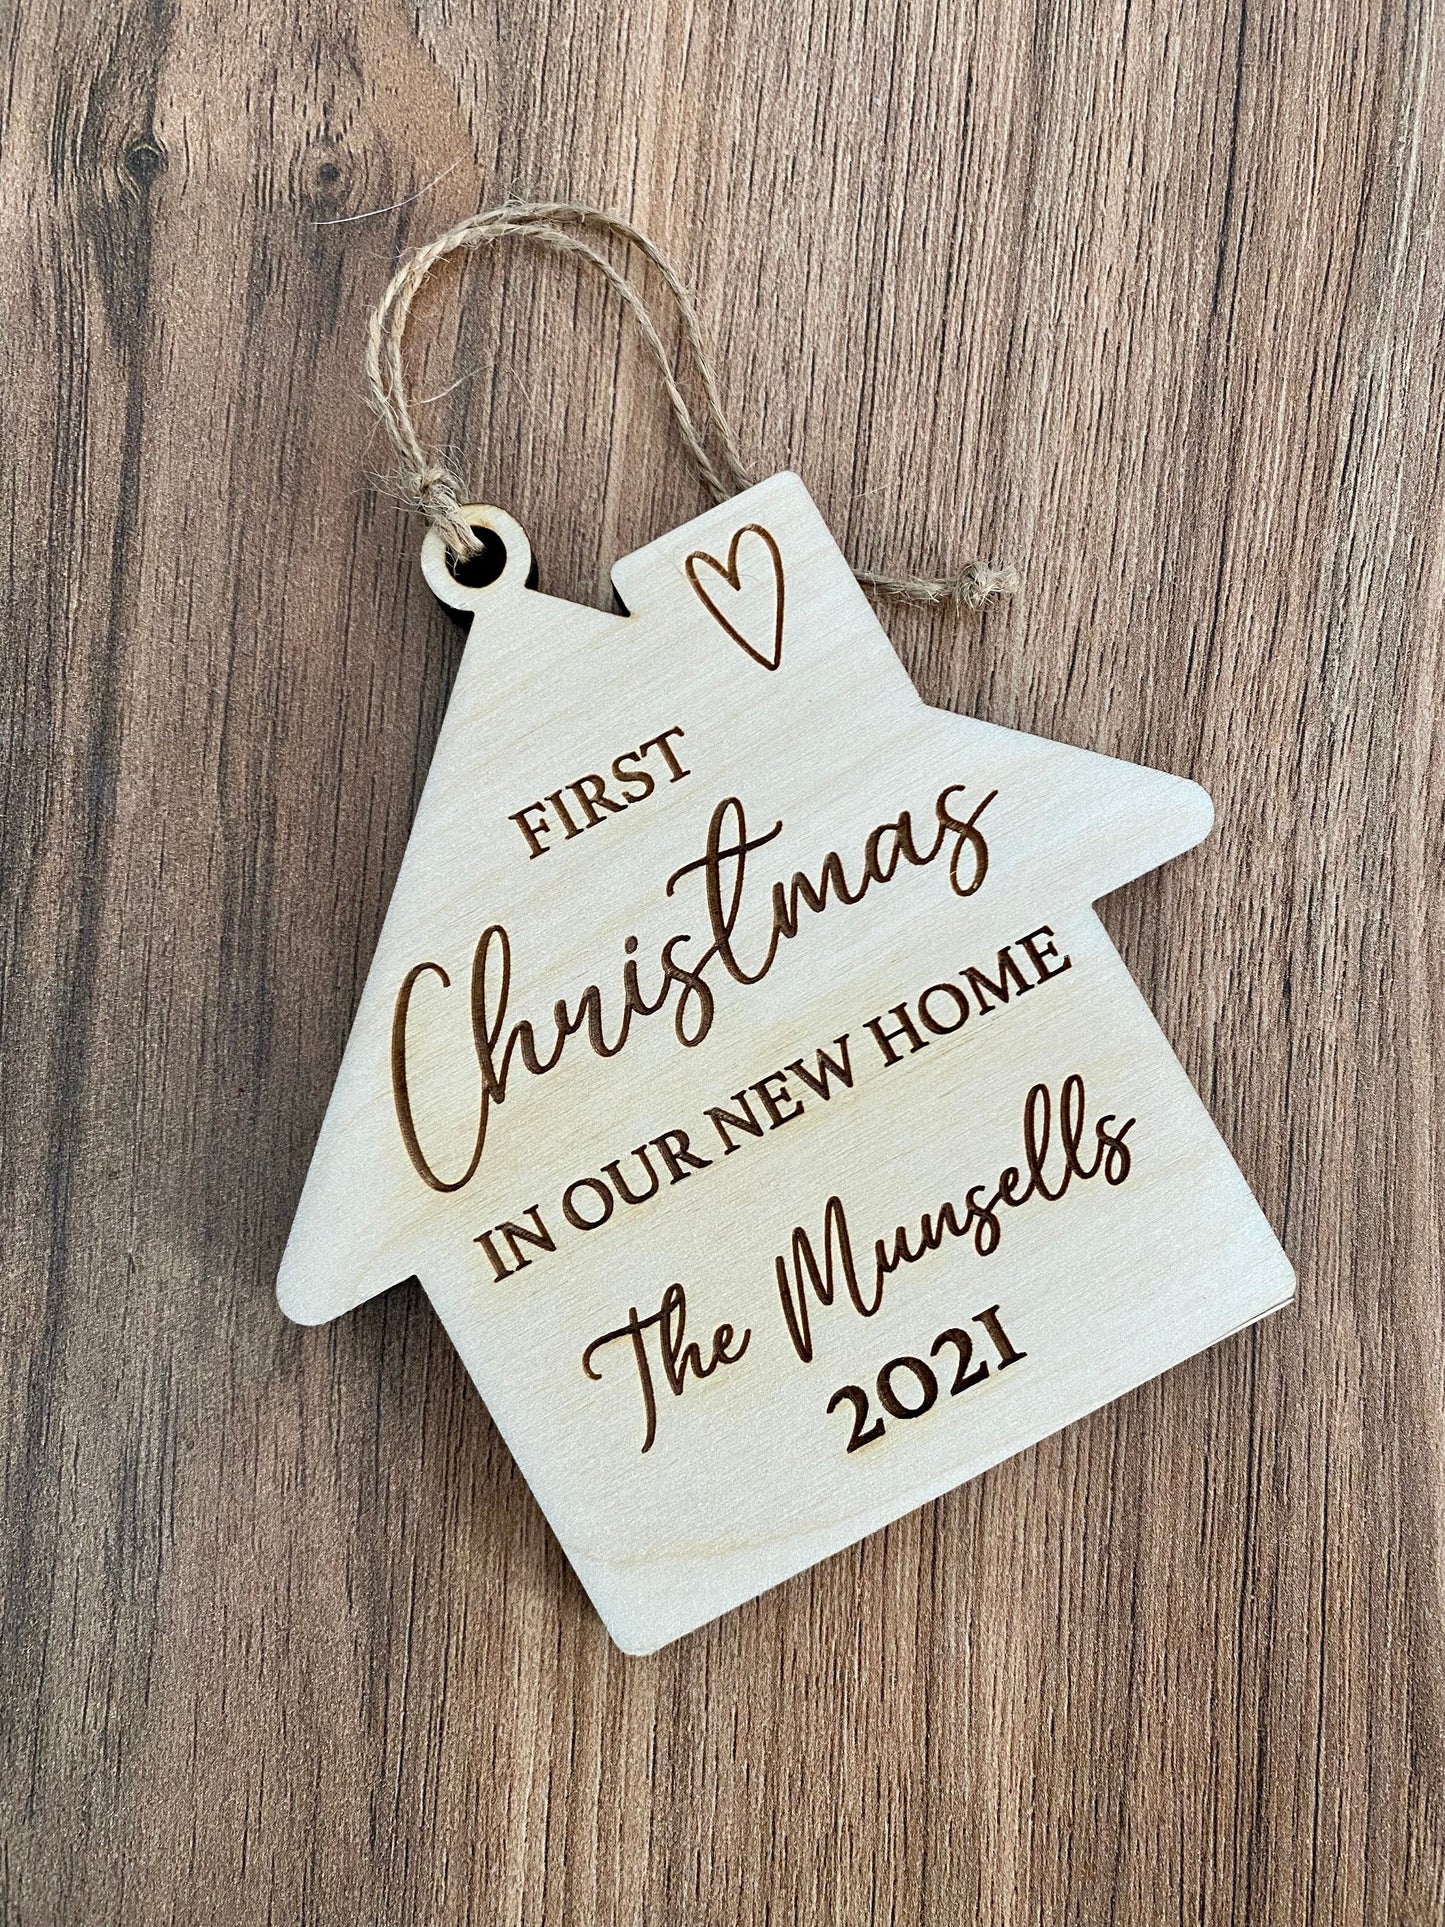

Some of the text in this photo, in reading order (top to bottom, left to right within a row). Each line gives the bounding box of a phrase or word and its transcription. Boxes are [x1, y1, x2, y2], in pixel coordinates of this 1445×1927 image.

[508, 725, 691, 859] FIRST
[391, 784, 999, 1194] Christmas
[472, 924, 1073, 1284] IN OUR NEW HOME
[582, 1073, 1137, 1455] The Munsells
[826, 1304, 1028, 1454] 2021
